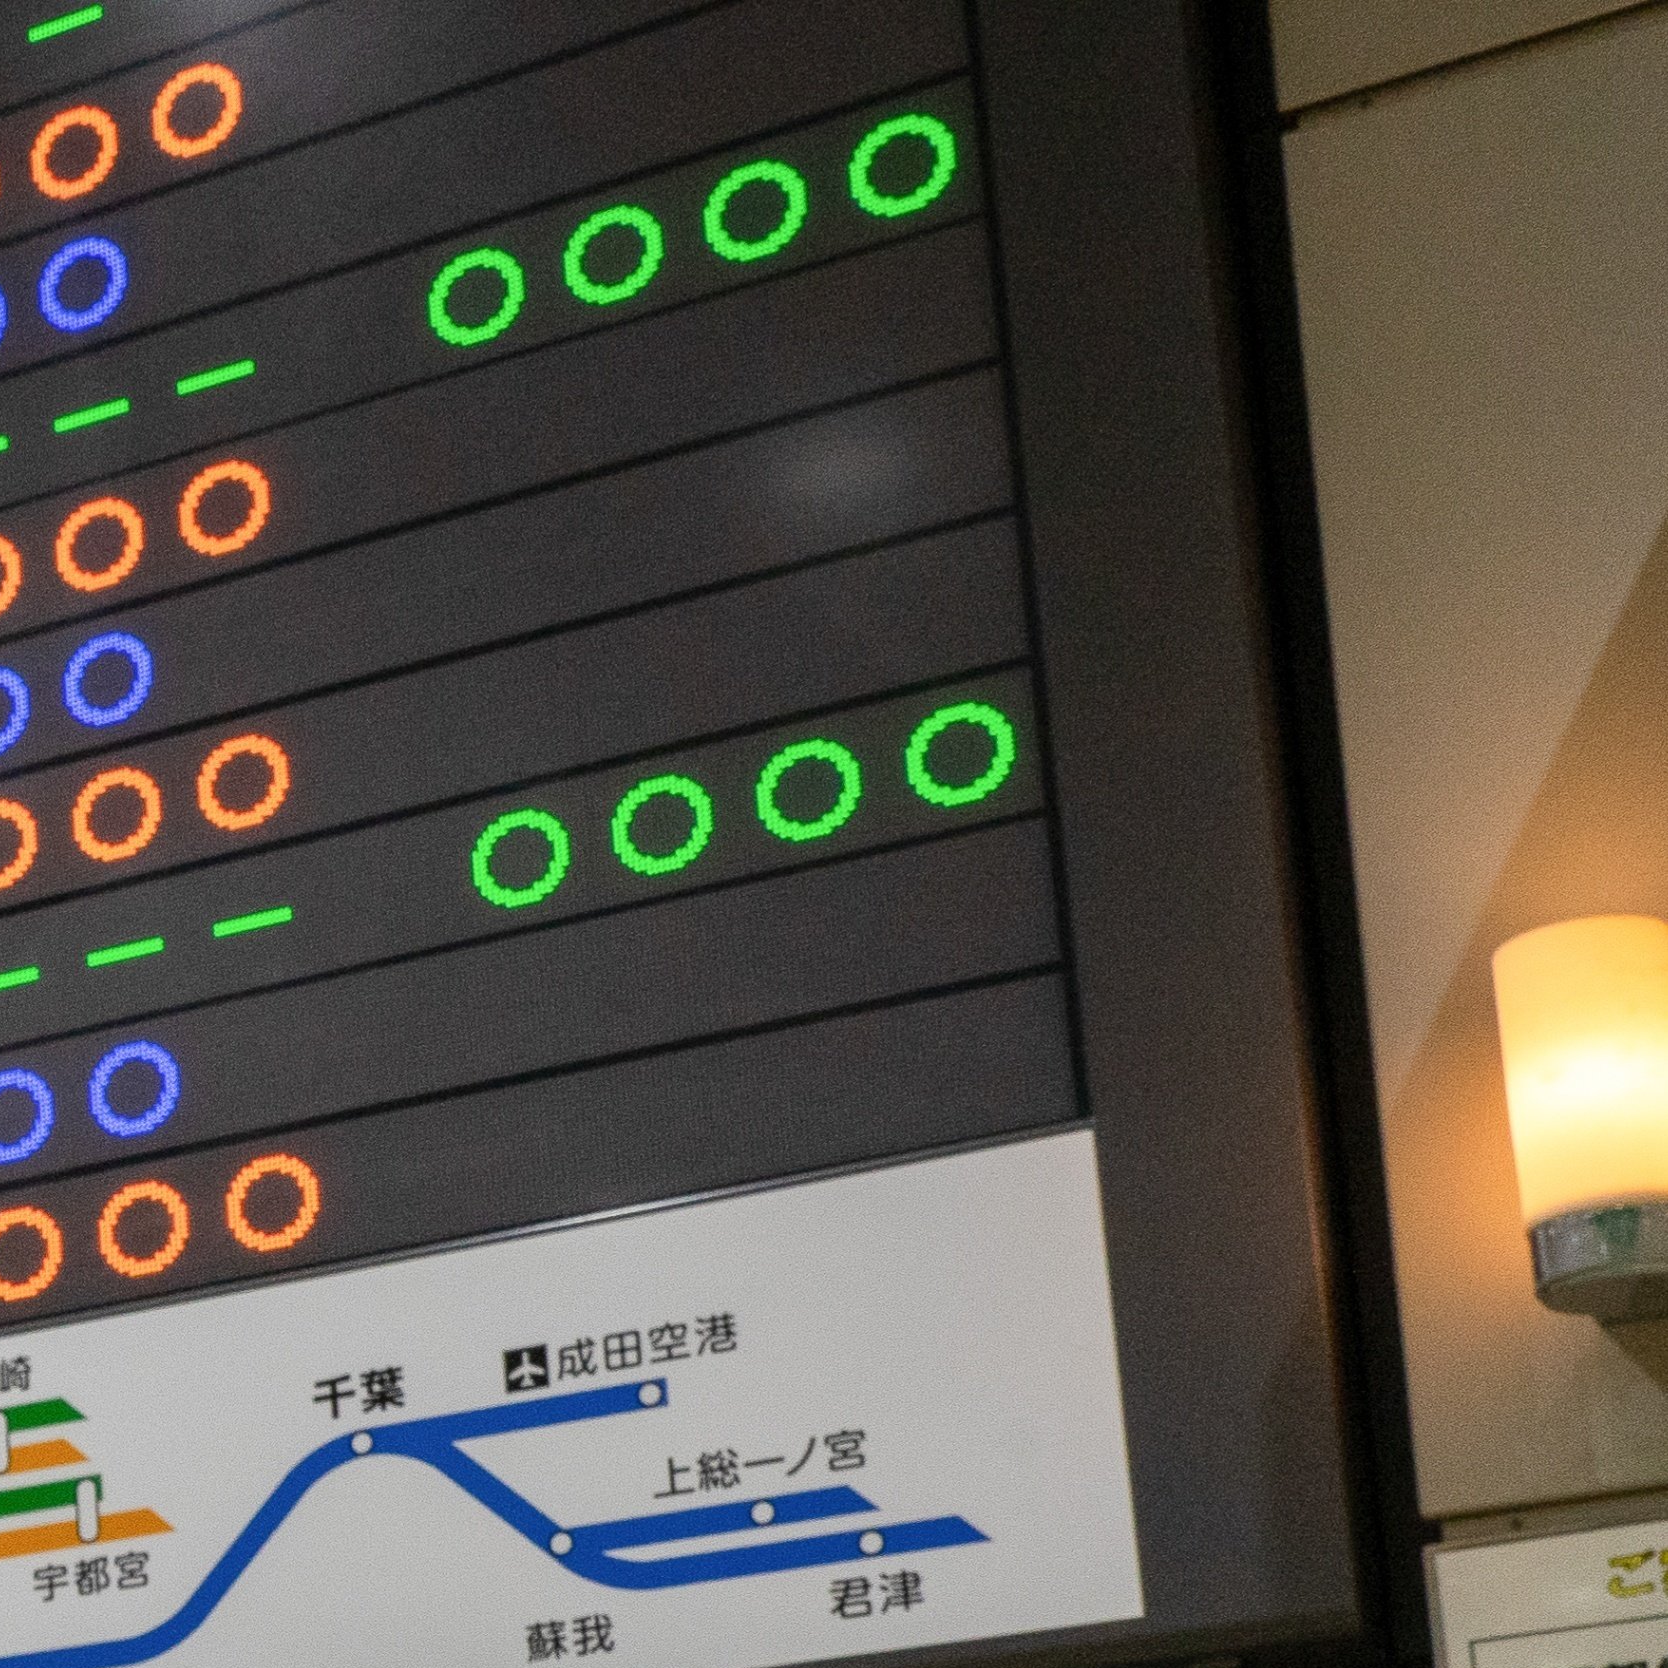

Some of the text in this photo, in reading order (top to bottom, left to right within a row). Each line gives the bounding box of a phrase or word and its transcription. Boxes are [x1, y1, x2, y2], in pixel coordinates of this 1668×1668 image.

[555, 1312, 739, 1383] 成田空港
[311, 1365, 405, 1418] 千葉
[653, 1427, 868, 1500] 上総一ノ宮
[32, 1551, 152, 1602] 宇都宮
[829, 1570, 924, 1620] 君津
[525, 1613, 616, 1664] 蘇我
